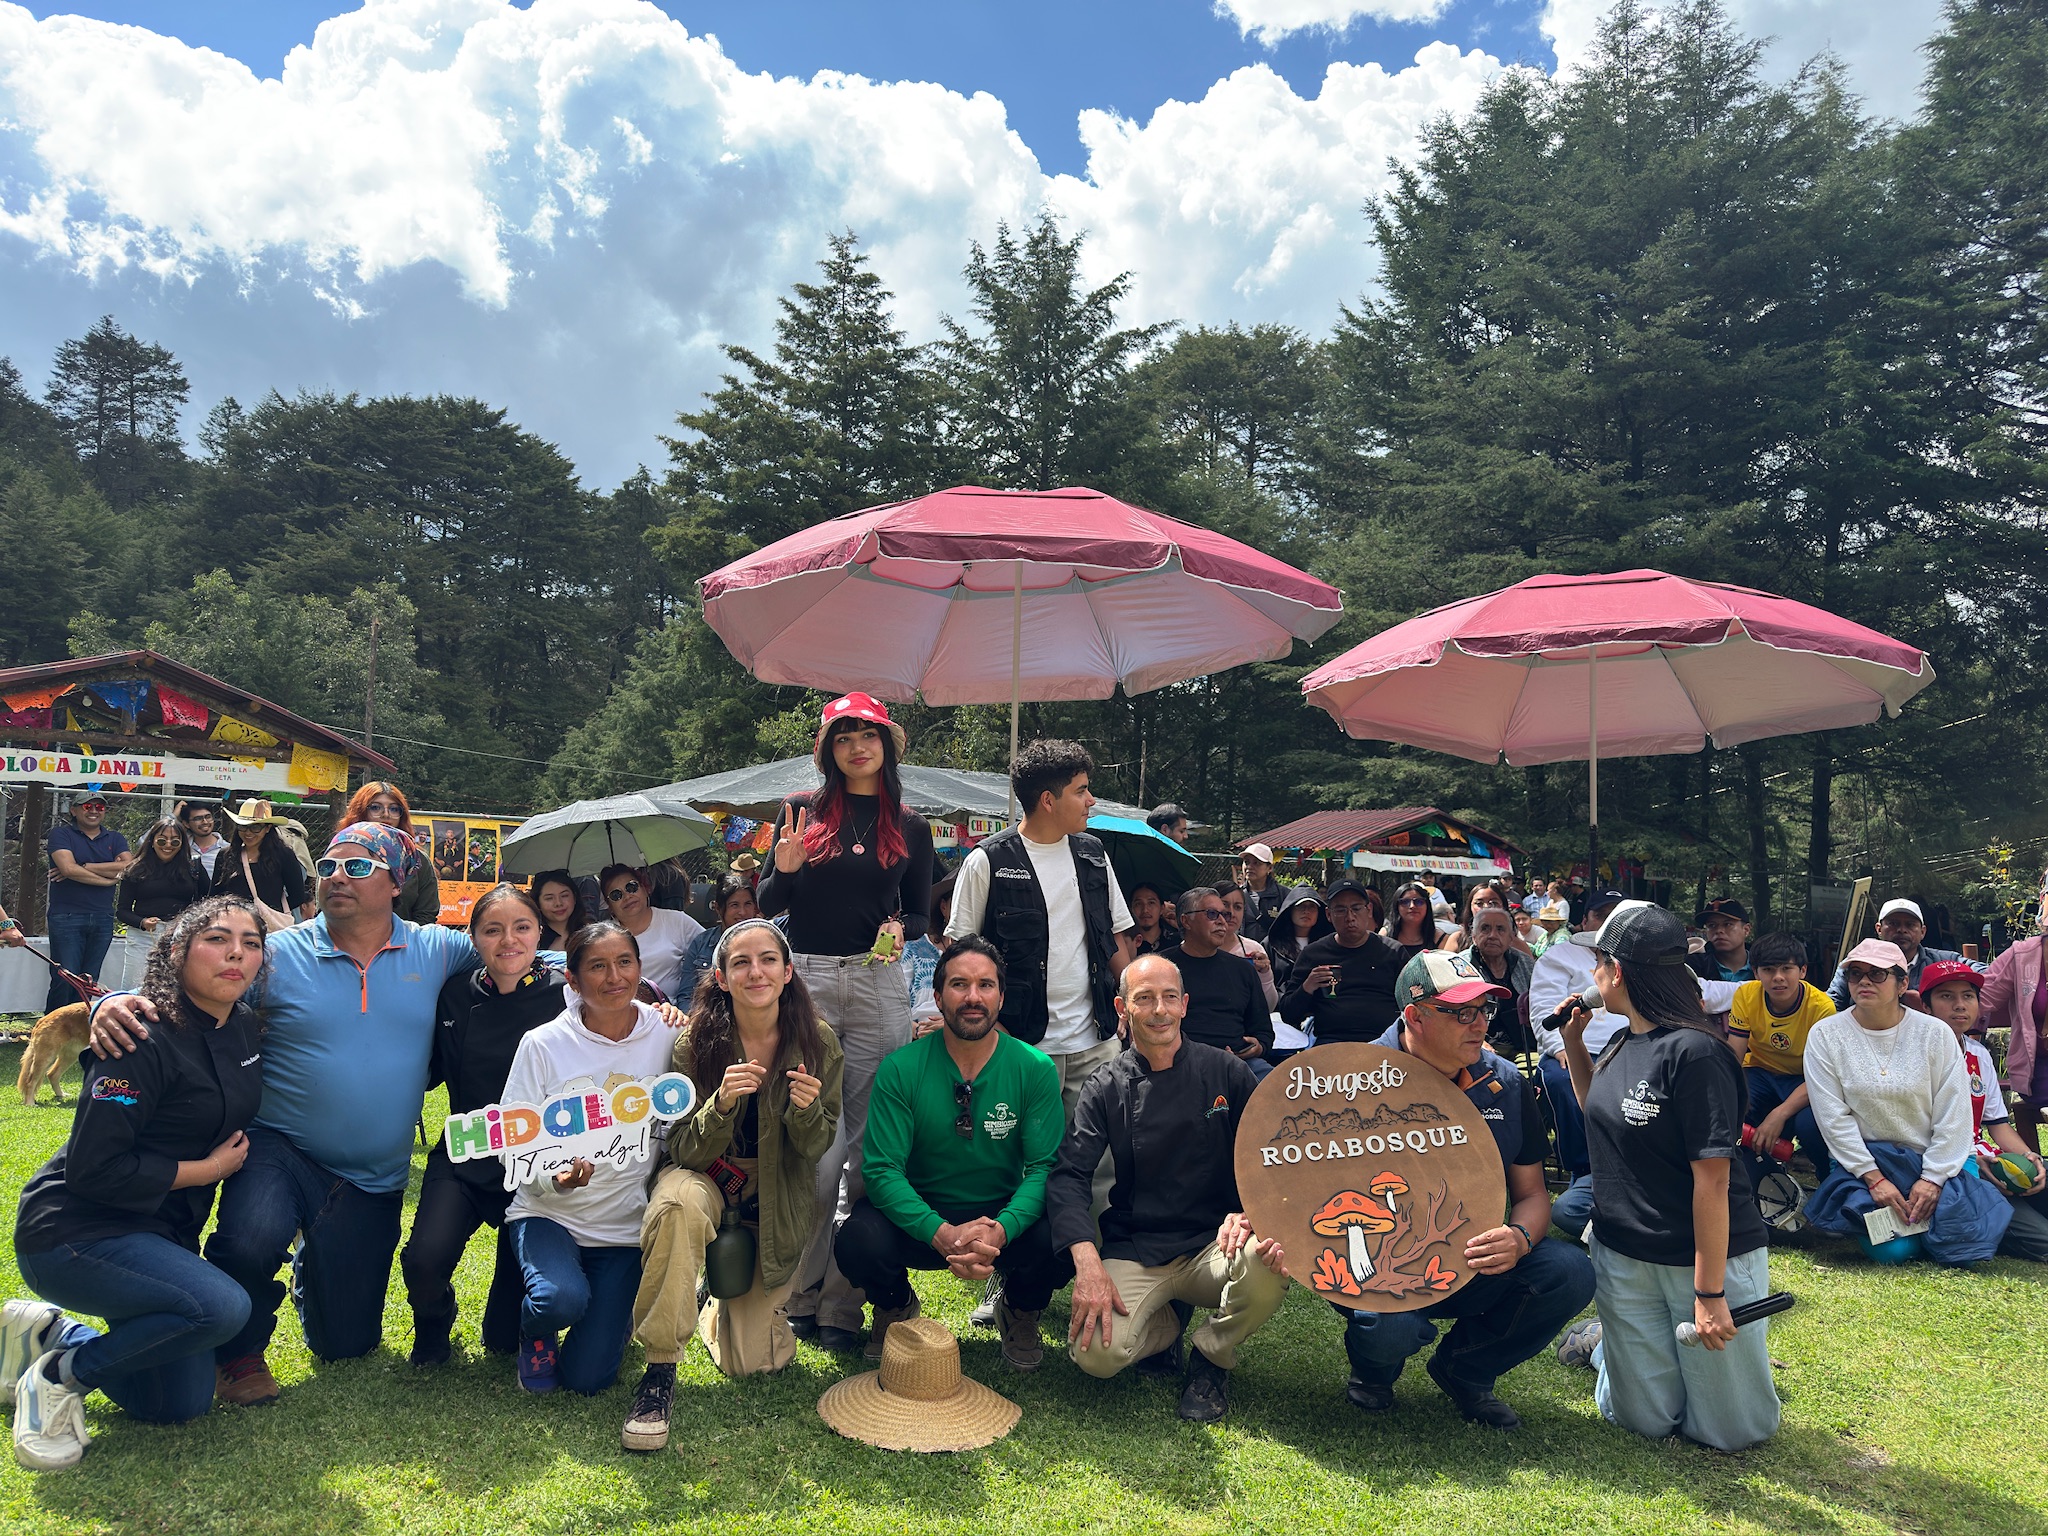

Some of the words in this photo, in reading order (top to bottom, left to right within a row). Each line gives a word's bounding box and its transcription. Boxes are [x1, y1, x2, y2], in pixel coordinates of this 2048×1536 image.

[80, 758, 166, 778] DANAEL
[971, 819, 992, 832] CHEF
[103, 1078, 130, 1089] KING
[1285, 1059, 1408, 1101] Hongosto
[510, 1145, 585, 1185] ¡Tiene
[594, 1127, 646, 1165] algo!
[1260, 1124, 1469, 1167] ROCABOSQUE
